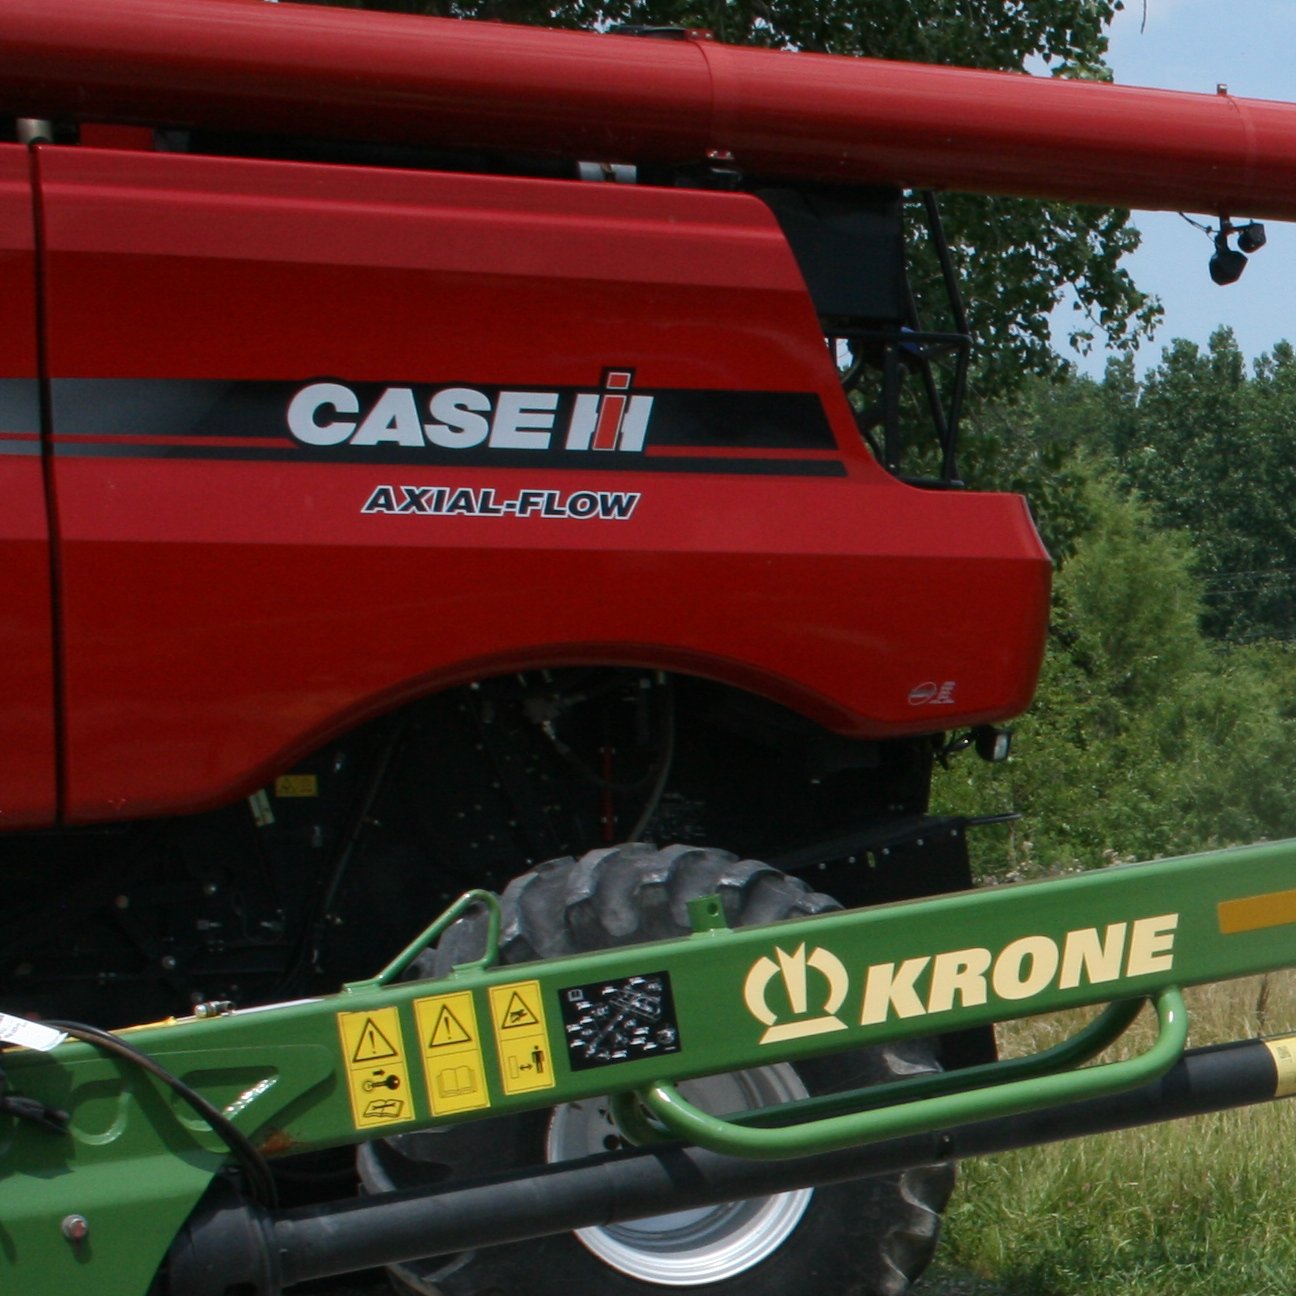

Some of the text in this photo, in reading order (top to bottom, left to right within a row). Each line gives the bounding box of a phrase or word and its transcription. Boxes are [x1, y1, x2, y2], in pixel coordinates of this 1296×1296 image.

[287, 383, 559, 449] CASE
[360, 485, 641, 520] AXIAL-FLOW
[861, 913, 1179, 1027] KRONE
